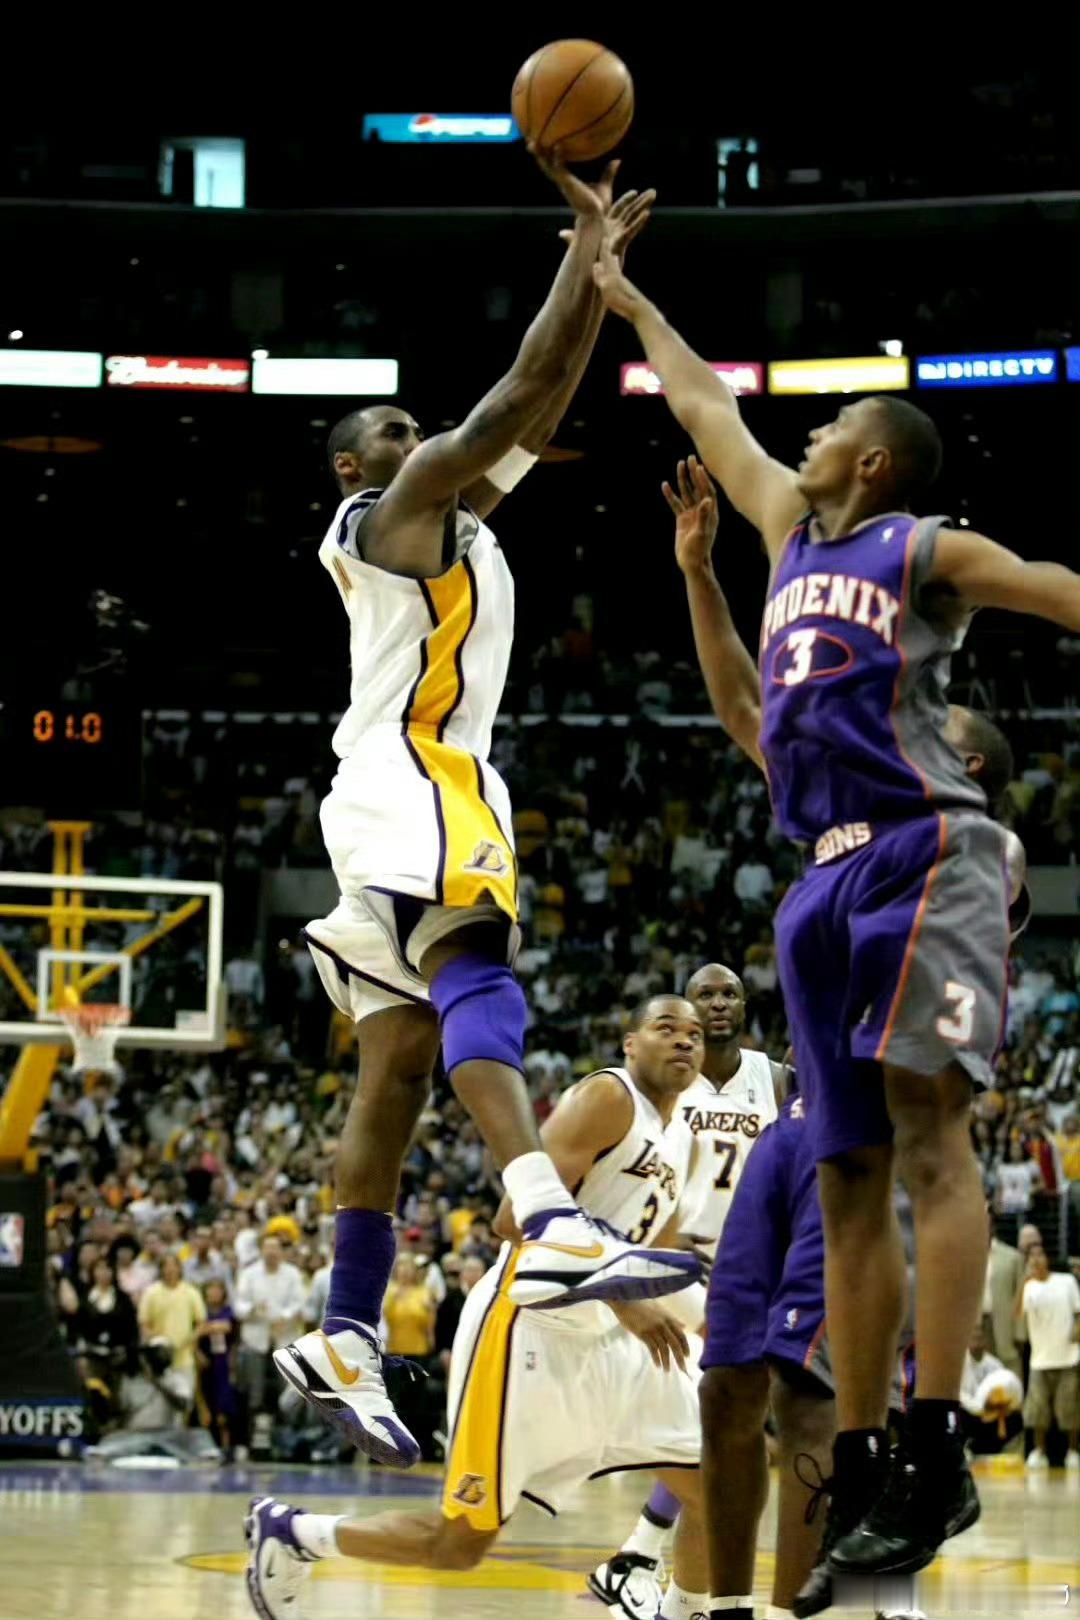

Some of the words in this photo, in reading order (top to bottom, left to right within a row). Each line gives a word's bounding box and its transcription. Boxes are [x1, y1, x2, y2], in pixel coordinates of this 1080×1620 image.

[763, 574, 899, 650] PHOENIX
[784, 628, 818, 686] 3
[936, 981, 976, 1042] 3
[714, 1139, 737, 1189] 7
[624, 1191, 659, 1245] 3
